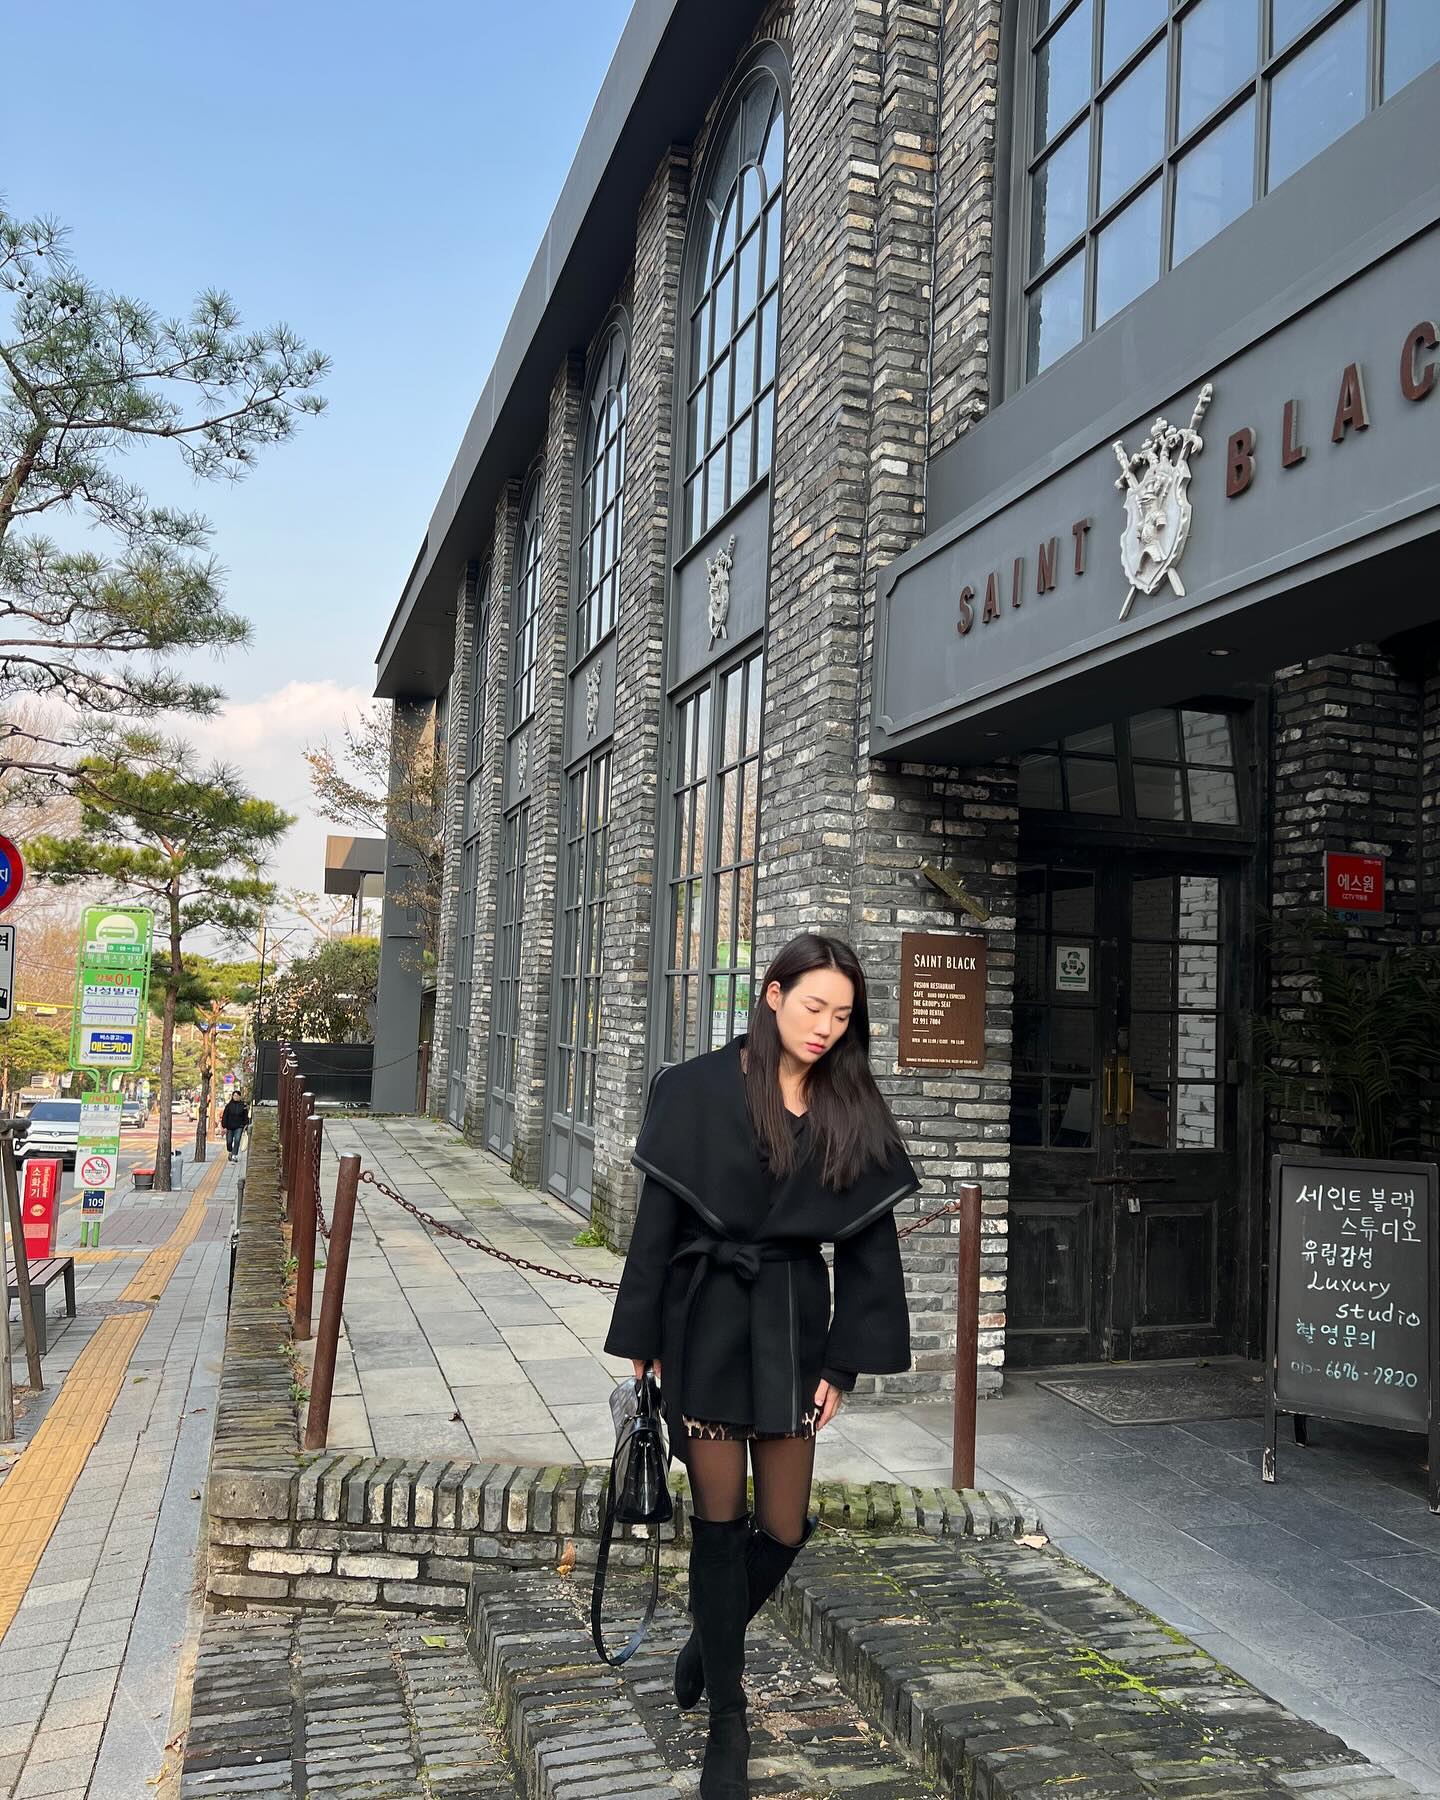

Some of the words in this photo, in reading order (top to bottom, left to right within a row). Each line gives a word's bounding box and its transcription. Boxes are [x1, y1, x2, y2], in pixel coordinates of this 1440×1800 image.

[957, 517, 1091, 635] SAINT
[1337, 873, 1374, 893] 에스원
[914, 953, 942, 968] SAINT
[946, 956, 976, 970] BLACK
[86, 986, 139, 996] 신성빌라
[30, 1167, 42, 1198] 소화기
[88, 1198, 104, 1207] 109
[1340, 1216, 1421, 1243] 스튜디오
[1307, 1270, 1391, 1300] Luxury
